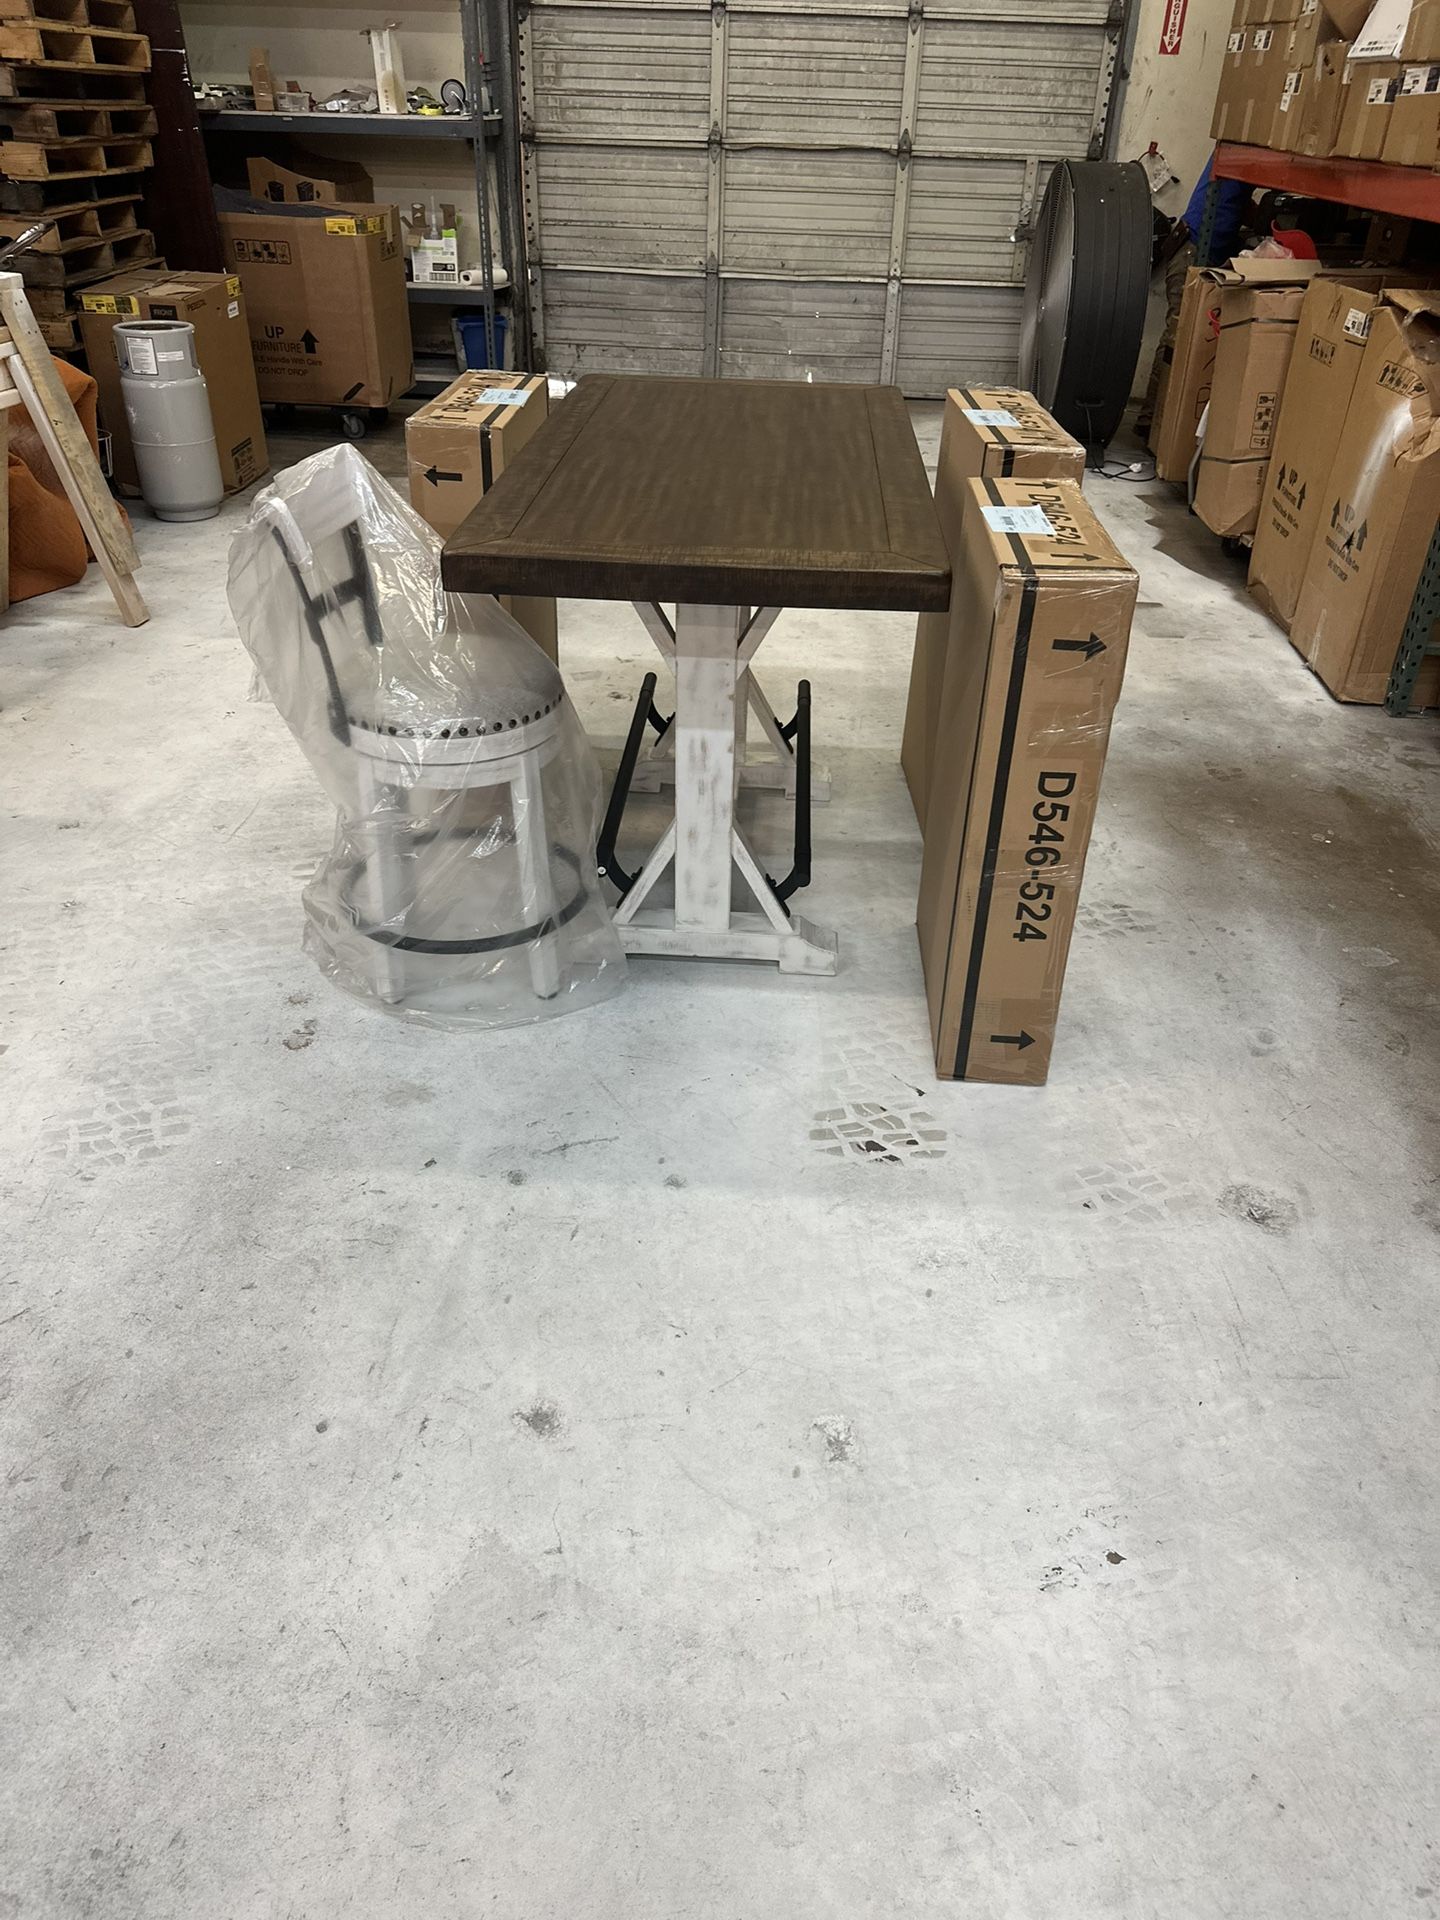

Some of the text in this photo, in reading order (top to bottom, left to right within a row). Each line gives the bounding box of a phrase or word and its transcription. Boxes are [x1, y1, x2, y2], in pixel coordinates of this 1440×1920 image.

[264, 325, 284, 339] UP
[251, 340, 302, 354] FURNITURE
[1012, 771, 1077, 942] D546-524
